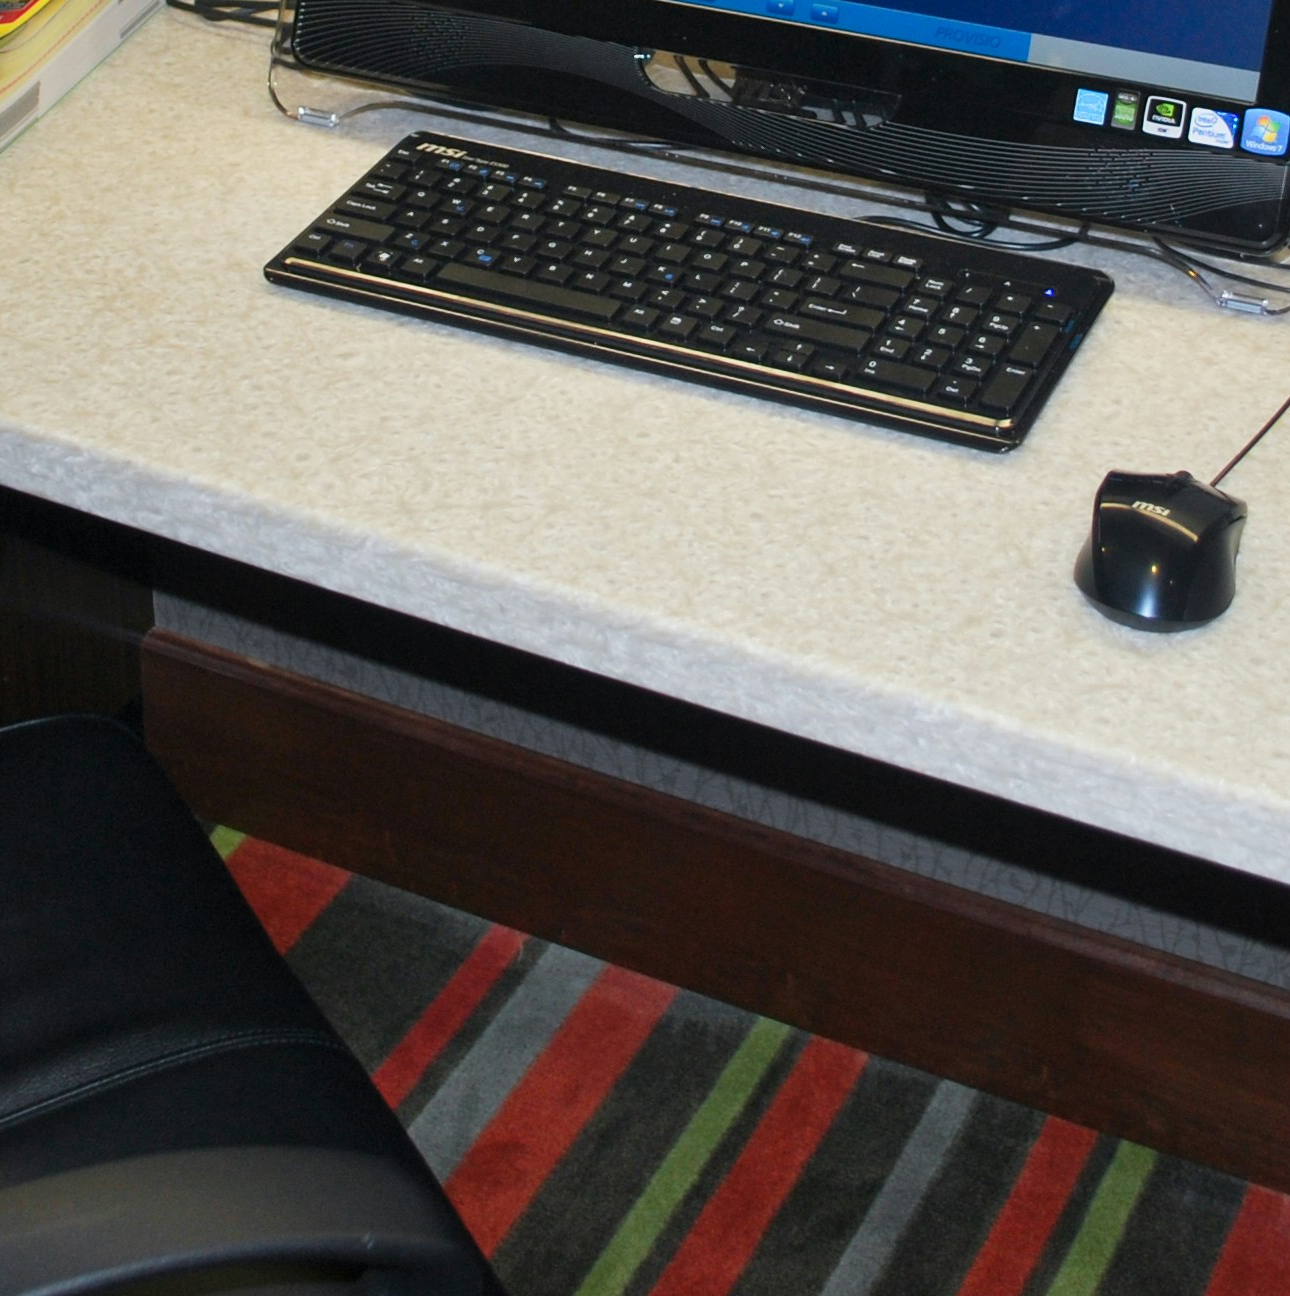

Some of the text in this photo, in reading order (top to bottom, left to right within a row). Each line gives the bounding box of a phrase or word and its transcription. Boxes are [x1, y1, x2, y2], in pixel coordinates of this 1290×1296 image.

[935, 25, 1002, 49] PROVISIO
[416, 142, 469, 159] msi
[1245, 139, 1276, 152] Windows
[1132, 500, 1170, 516] msi
